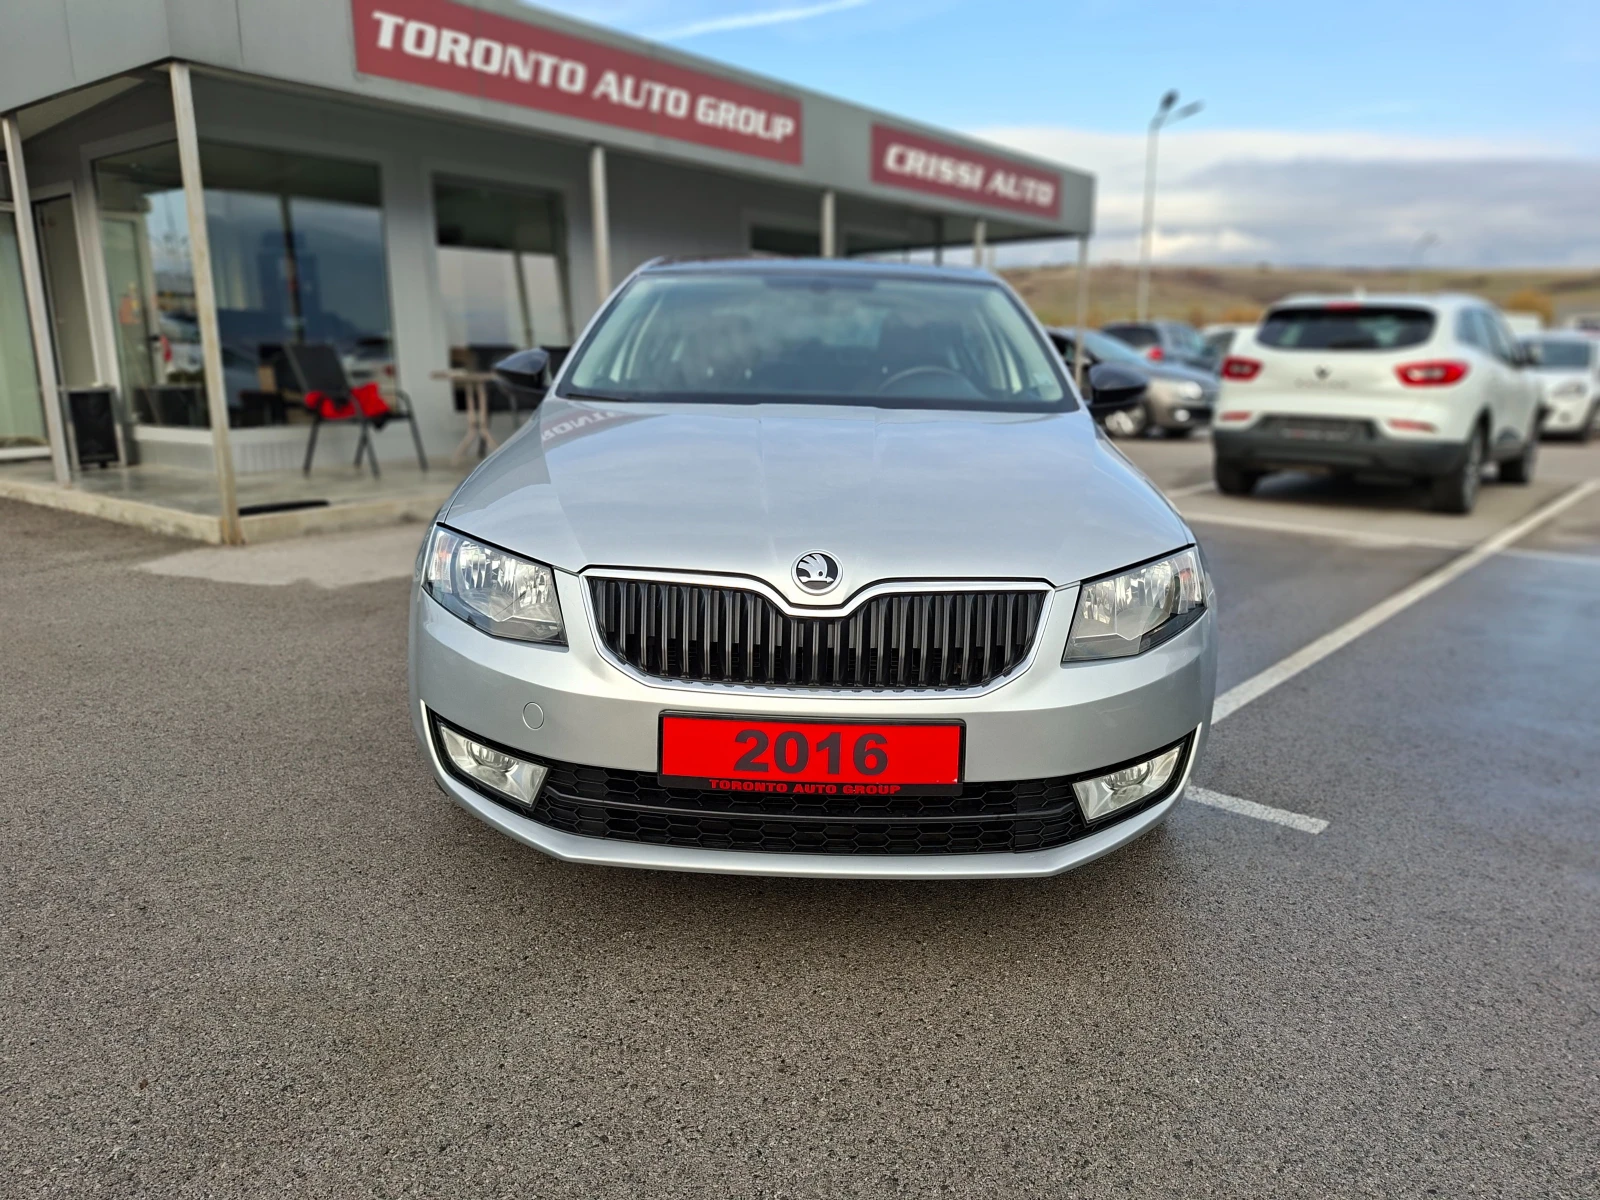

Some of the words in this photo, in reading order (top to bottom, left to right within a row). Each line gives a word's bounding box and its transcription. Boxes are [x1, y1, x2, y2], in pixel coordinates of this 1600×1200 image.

[372, 11, 587, 94] TORONTO
[593, 71, 689, 118] AUTO
[696, 96, 796, 142] GROUP
[884, 143, 986, 191] CRISSI
[986, 170, 1055, 207] AUTO
[734, 729, 888, 775] 2016
[710, 779, 788, 793] TORONTO
[793, 784, 837, 794] AUTO
[844, 785, 901, 794] GROUP
